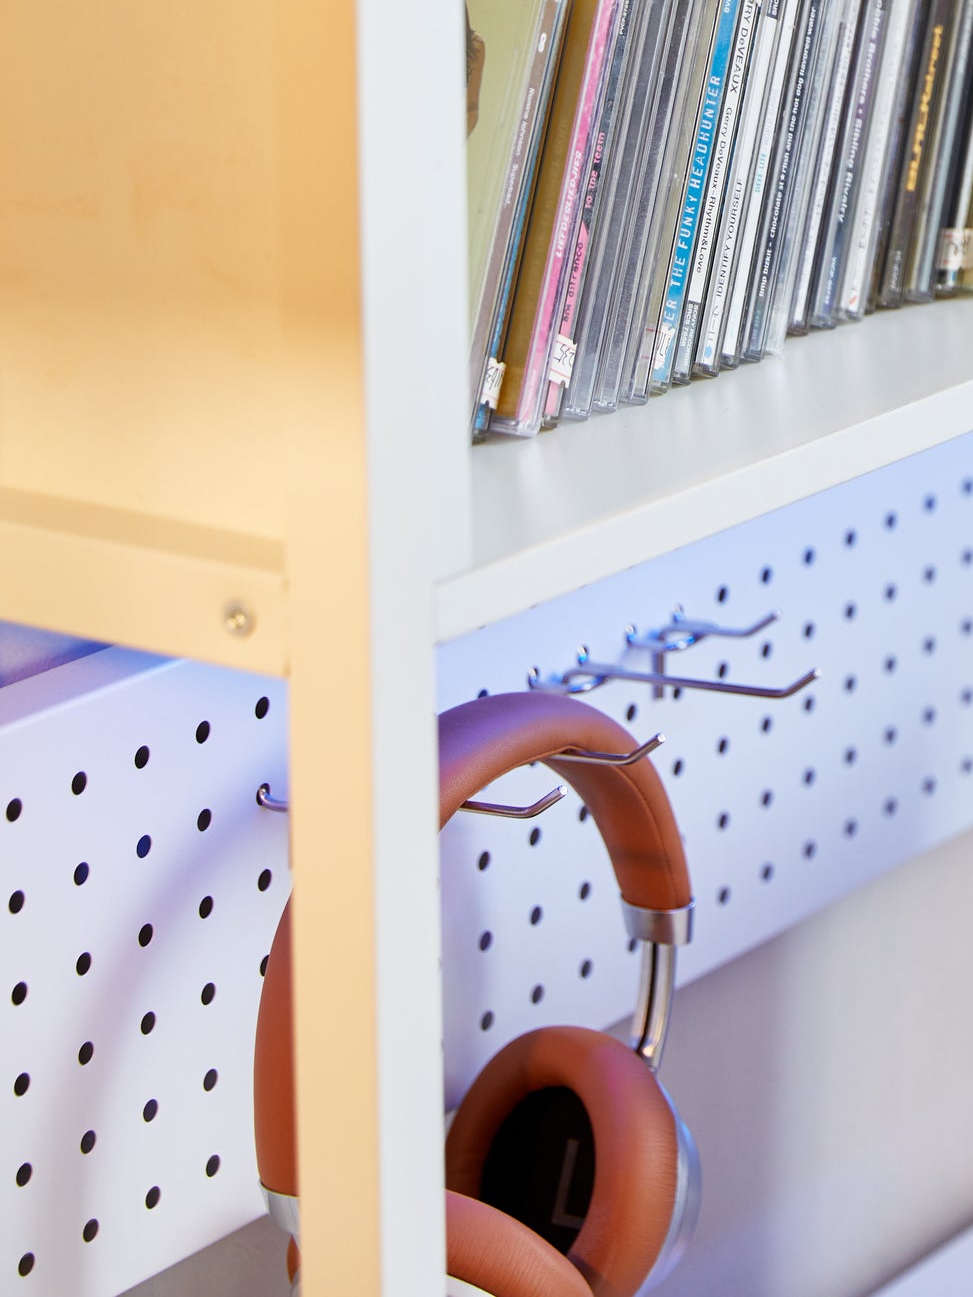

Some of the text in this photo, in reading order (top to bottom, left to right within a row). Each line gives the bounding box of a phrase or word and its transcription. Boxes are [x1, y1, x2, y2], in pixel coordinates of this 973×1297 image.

[807, 6, 817, 35] water
[729, 27, 748, 93] DeVEAUX
[799, 36, 811, 75] flavored
[795, 76, 804, 96] dog
[720, 106, 733, 137] Gerry
[792, 97, 800, 114] hot
[516, 120, 528, 155] Johnson
[689, 74, 721, 189] HEADHUNTER
[788, 114, 797, 131] the
[785, 132, 794, 150] and
[676, 195, 698, 249] FUNKY
[769, 191, 783, 238] chocolate
[714, 177, 744, 296] IDENTIFY YOURSELF
[669, 255, 686, 287] THE
[762, 248, 772, 274] bizkit
[758, 275, 768, 297] limp
[550, 1138, 585, 1230] L
